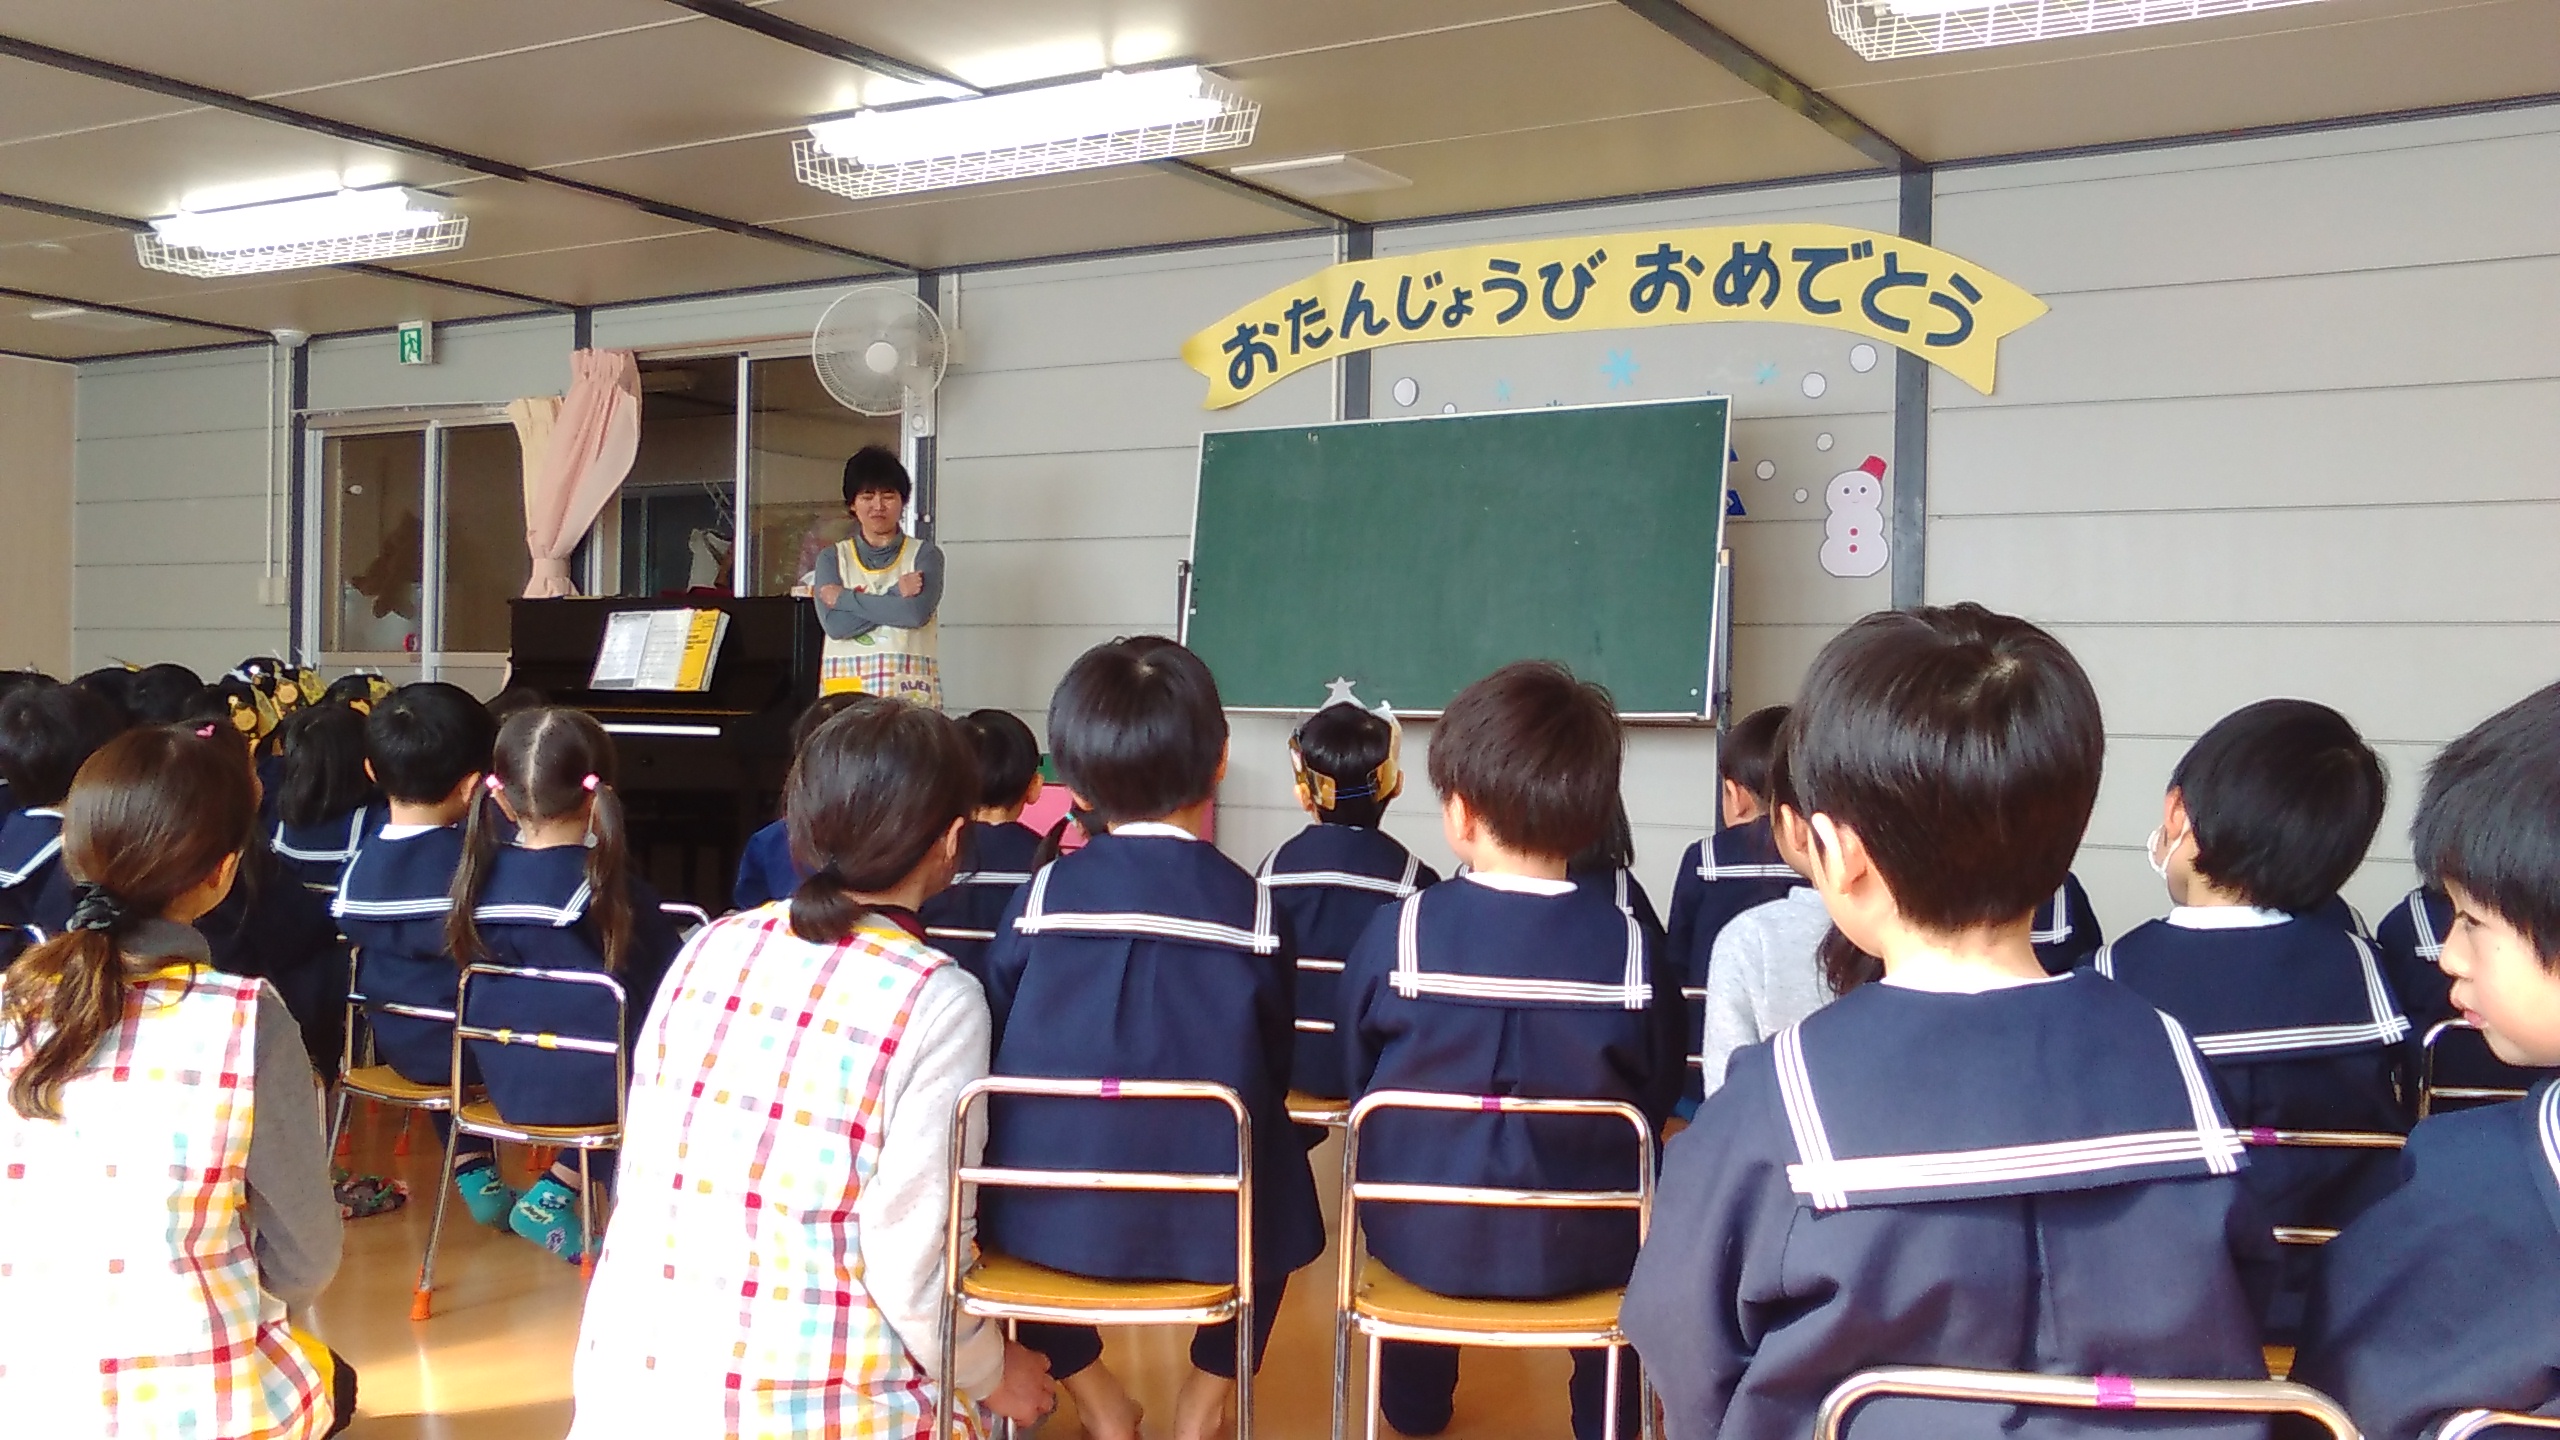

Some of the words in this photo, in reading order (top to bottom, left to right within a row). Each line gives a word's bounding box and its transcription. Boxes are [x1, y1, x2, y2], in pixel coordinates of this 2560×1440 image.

[1221, 247, 1607, 390] おたんじょうび
[1628, 239, 1983, 347] おめでとう
